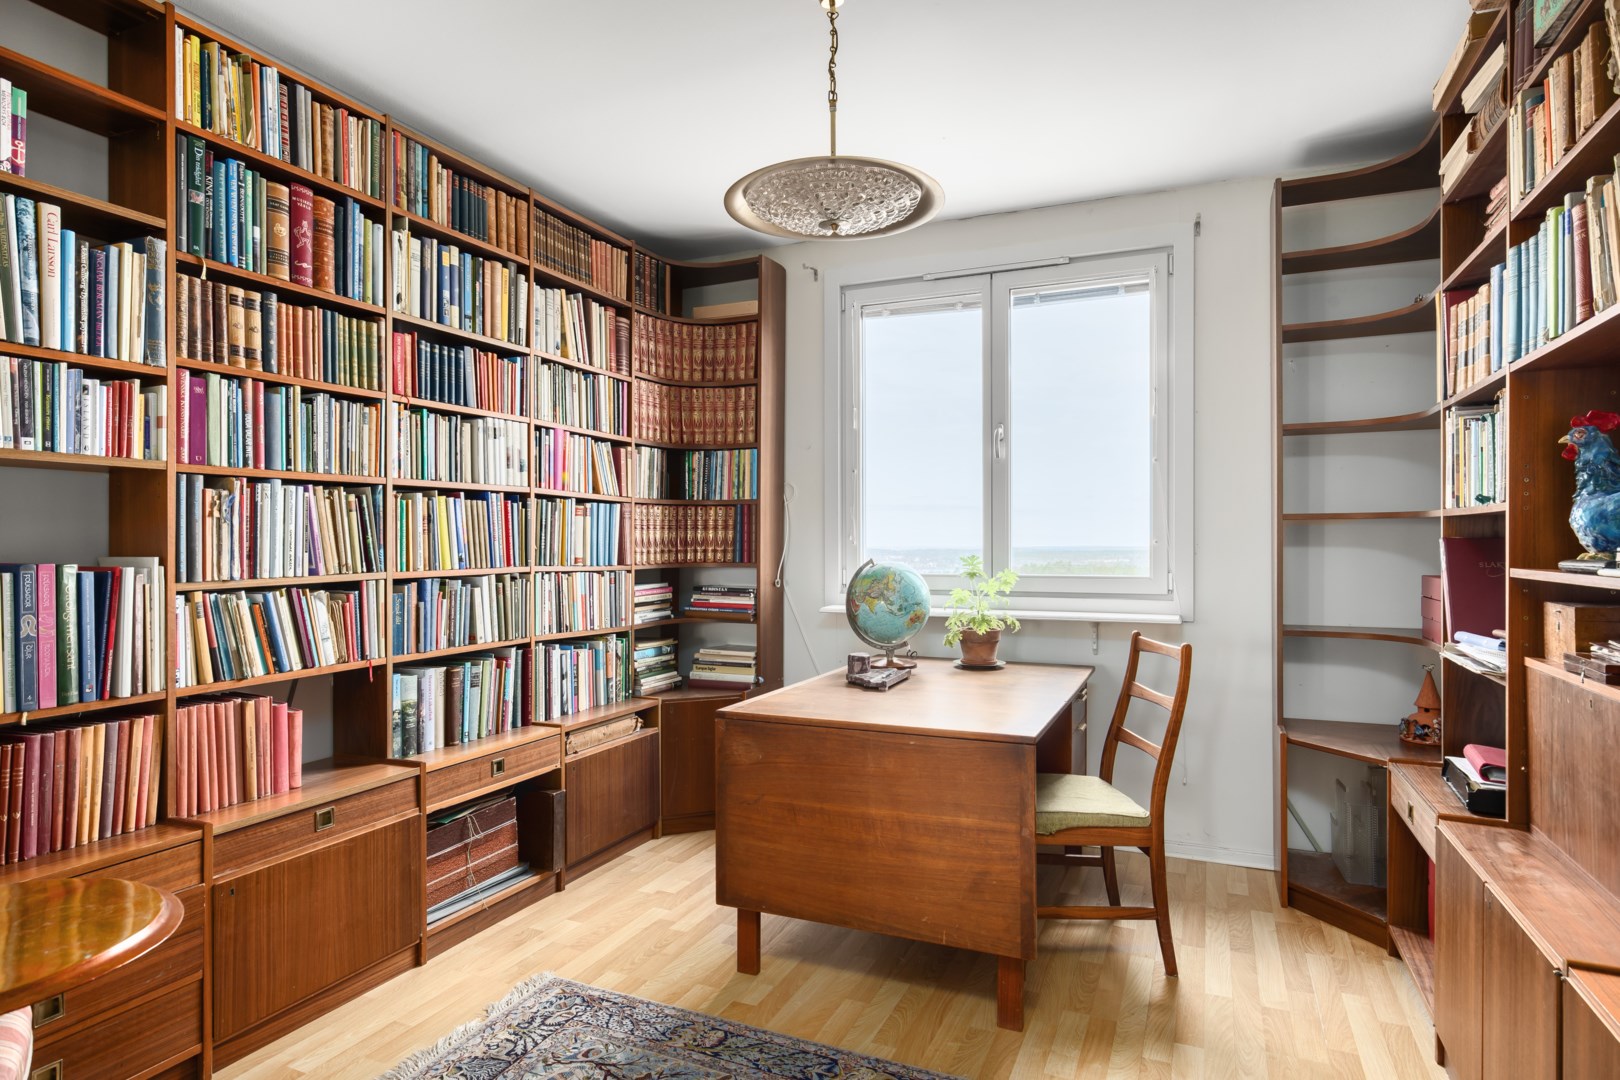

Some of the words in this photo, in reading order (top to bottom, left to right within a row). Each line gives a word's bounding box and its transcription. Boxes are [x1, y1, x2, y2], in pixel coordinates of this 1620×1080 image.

[195, 147, 204, 161] Din
[206, 175, 214, 197] KINA
[47, 212, 58, 236] Carl
[46, 237, 59, 279] Larsson
[80, 246, 88, 264] Johan
[96, 253, 104, 282] INGMAR
[96, 283, 104, 319] BERGMAN
[24, 574, 32, 608] FOLKSAGOR
[42, 574, 51, 608] FOLKSAGOR
[67, 623, 75, 649] men
[67, 650, 76, 671] sant
